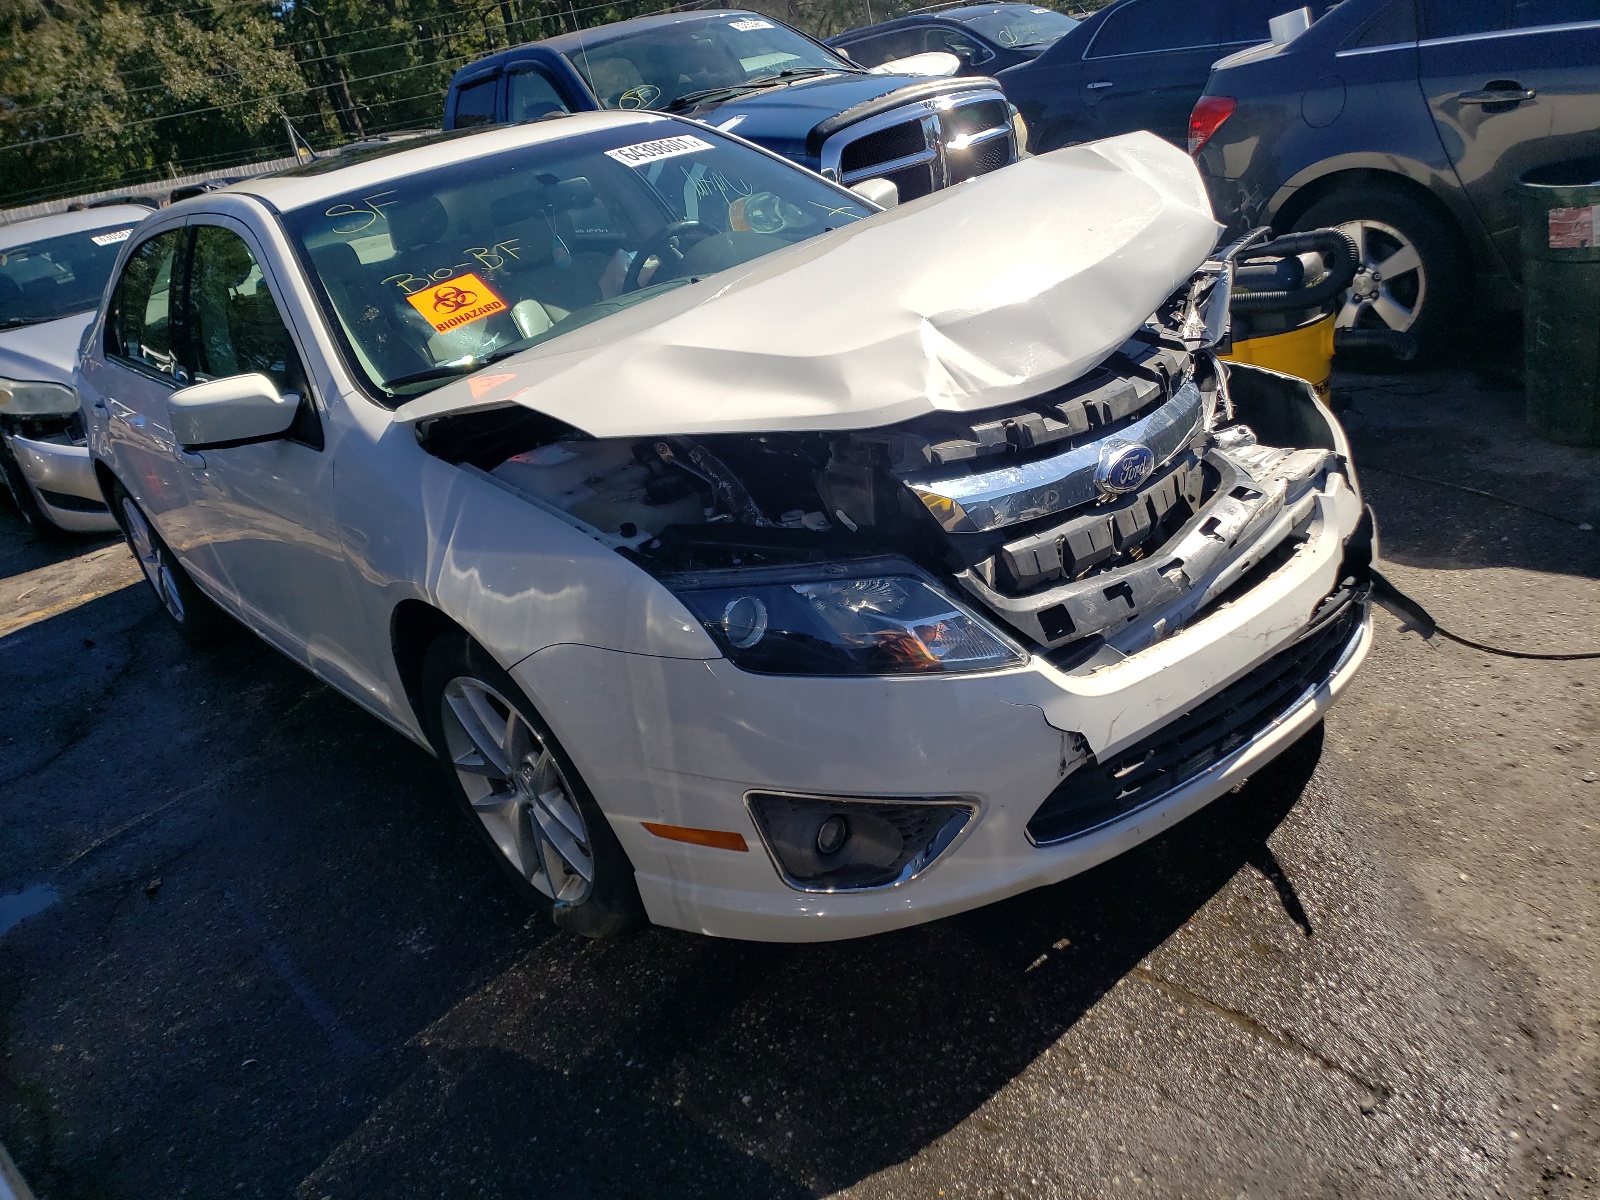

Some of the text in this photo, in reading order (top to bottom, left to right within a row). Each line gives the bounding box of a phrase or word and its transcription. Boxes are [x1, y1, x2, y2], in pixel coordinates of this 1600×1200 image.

[617, 137, 695, 161] 64398601
[325, 189, 398, 234] SF
[435, 301, 502, 332] BIOHAZARD
[1120, 453, 1148, 484] Ford
